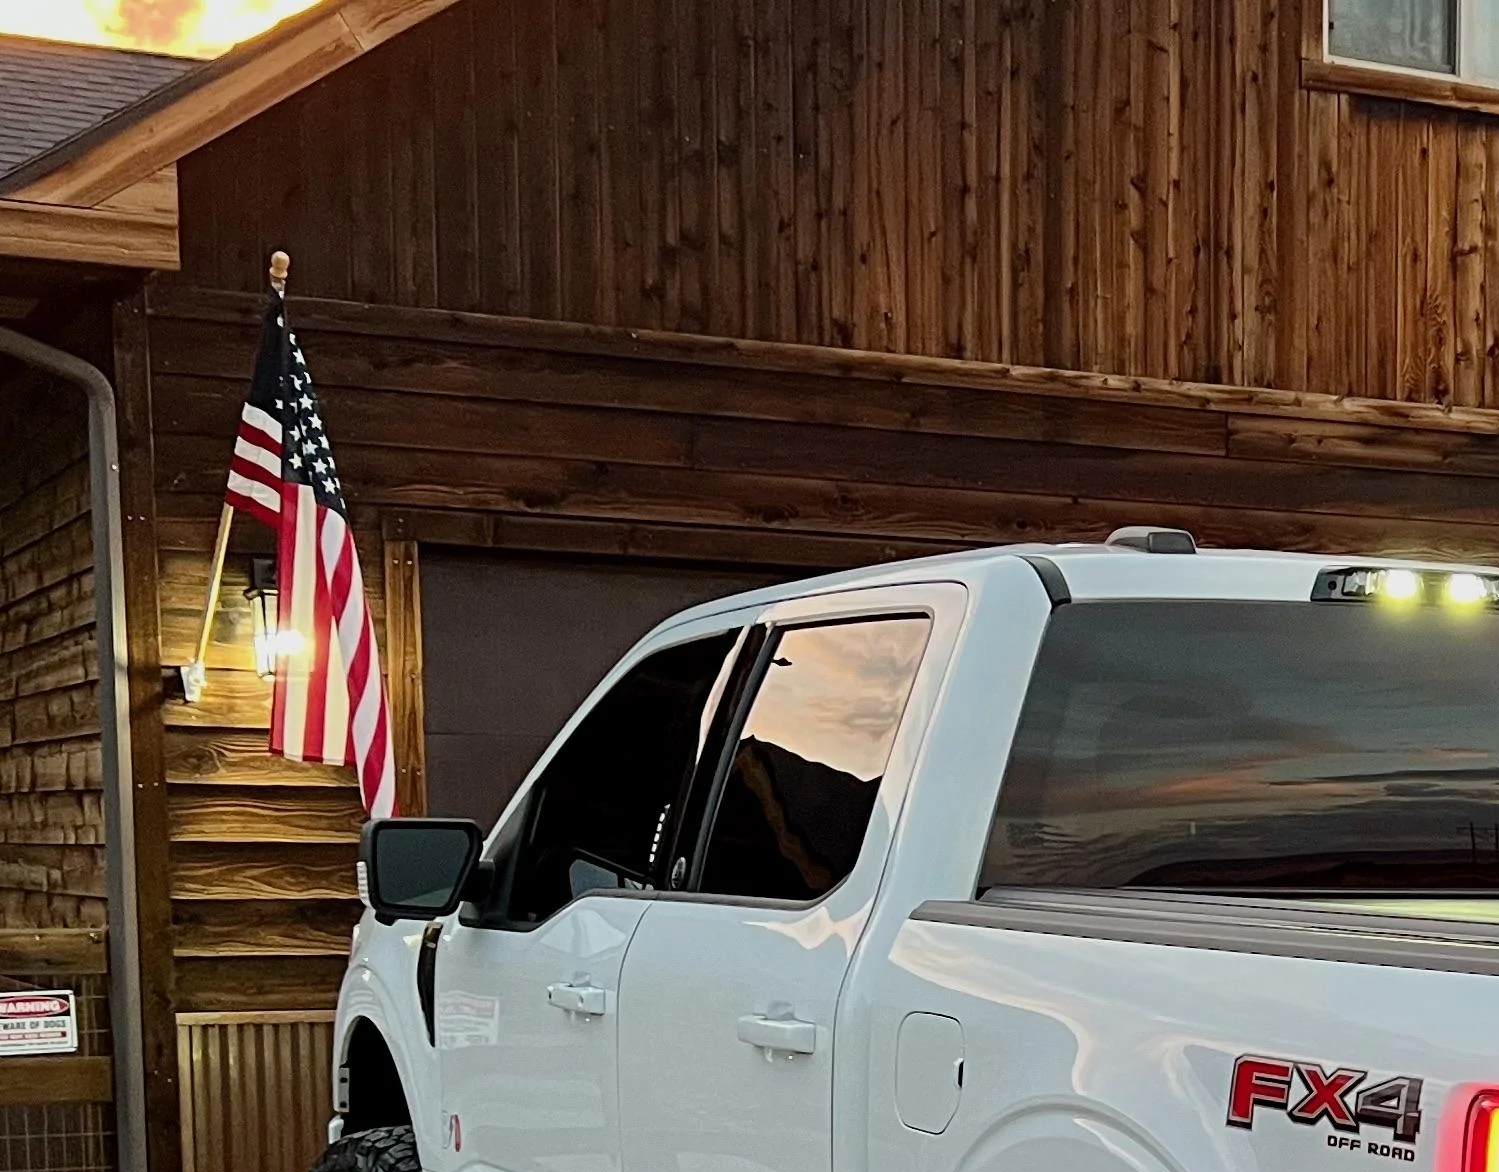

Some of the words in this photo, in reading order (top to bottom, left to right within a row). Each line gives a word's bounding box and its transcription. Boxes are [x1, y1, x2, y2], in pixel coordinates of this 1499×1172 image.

[1226, 1054, 1424, 1144] FX4
[1327, 1135, 1361, 1150] OFF
[1367, 1142, 1416, 1162] ROAD
